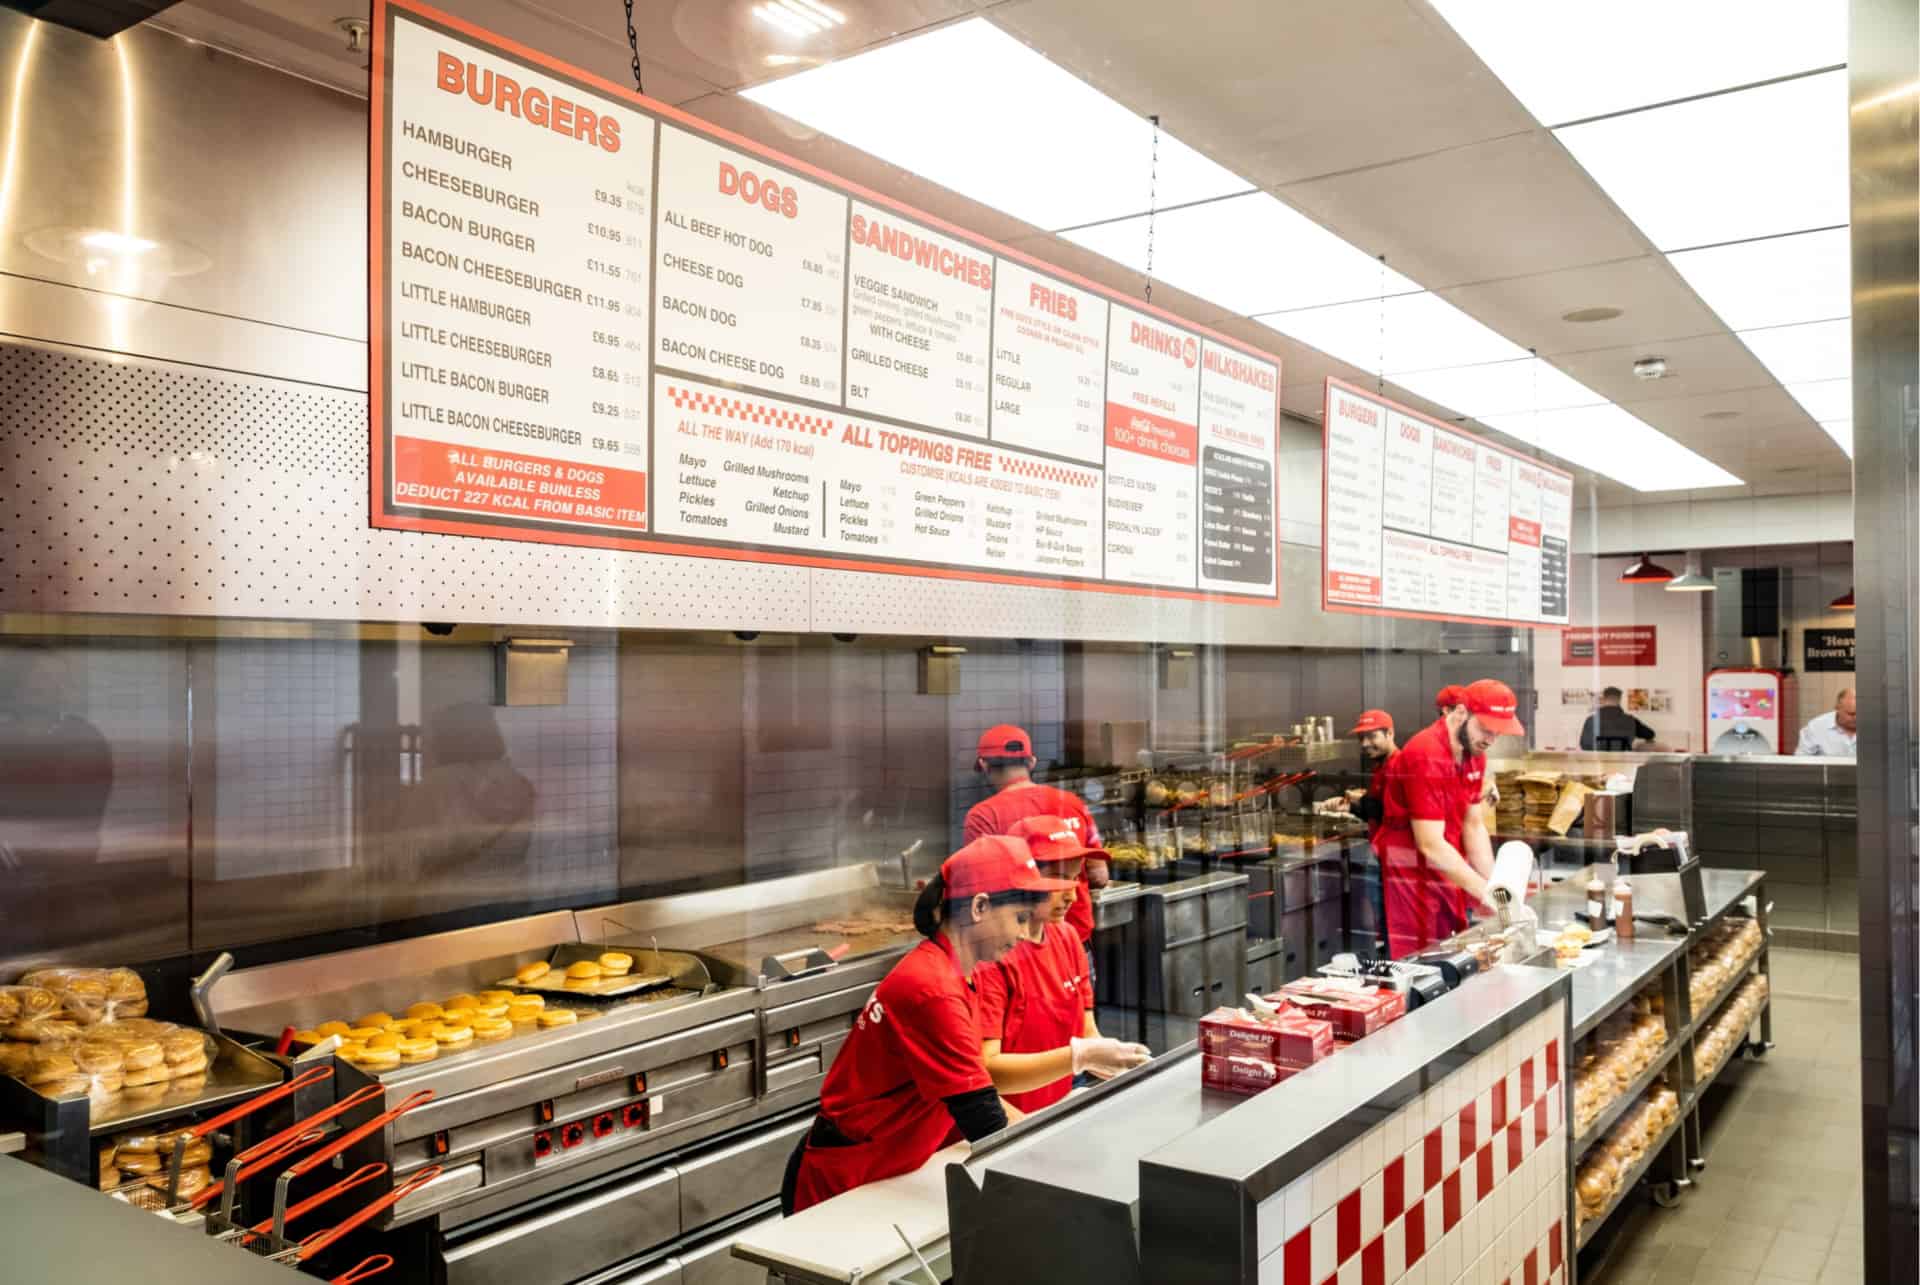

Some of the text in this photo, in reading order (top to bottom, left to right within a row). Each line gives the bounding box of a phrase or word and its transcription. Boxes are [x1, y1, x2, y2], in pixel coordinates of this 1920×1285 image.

[437, 50, 621, 153] BURGERS
[402, 120, 622, 208] HAMBURGER £9.35
[402, 160, 622, 243] CHEESEBURGER £10.95
[718, 161, 798, 219] DOGS
[402, 201, 621, 278] BACON BURGER £11.55
[664, 209, 688, 230] ALL
[690, 217, 721, 239] BEEF
[723, 228, 747, 248] HOT
[748, 238, 774, 258] DOG
[851, 214, 992, 290] SANDWICHES
[401, 241, 620, 313] BACON CHEESEBURGER £11.95
[663, 252, 713, 278] CHEESE
[716, 268, 744, 289] DOG
[853, 273, 889, 296] VEGGIE
[890, 286, 939, 313] SANDWICH
[1029, 282, 1077, 322] FRIES
[401, 281, 620, 348] LITTLE HAMBURGER £6.95
[662, 295, 707, 320] BACON
[709, 307, 737, 327] DOG
[401, 321, 619, 383] LITTLE CHEESEBURGER £8.65
[869, 323, 894, 339] WITH
[894, 331, 931, 352] CHEESE
[1130, 320, 1182, 361] DRINKS
[661, 338, 706, 361] BACON
[709, 348, 756, 373] CHEESE
[759, 361, 785, 379] DOG
[851, 347, 930, 379] GRILLED CHEESE
[996, 349, 1021, 365] LITTLE
[1204, 348, 1275, 392] MILKSHAKES
[401, 361, 447, 385] LITTLE
[450, 371, 495, 394] BACON
[498, 380, 549, 403] BURGER
[850, 384, 870, 400] BLT
[996, 374, 1032, 393] REGULAR
[995, 399, 1022, 416] LARGE
[401, 402, 619, 453] LITTLE BACON CHEESEBURGER £9.65
[677, 416, 700, 437] ALL
[701, 423, 723, 441] THE
[724, 430, 749, 447] WAY
[841, 423, 993, 472] ALL TOPPINGS FREE
[451, 451, 605, 484] ALL BURGERS & DOGS
[679, 452, 809, 486] Mayo Grilled Mushrooms
[396, 482, 645, 523] DEDUCT 227 KCAL FROM BASIC ITEM
[455, 471, 600, 501] AVAILABLE BUNLESS
[679, 472, 810, 503] Lettuce Ketchup
[839, 479, 863, 494] Mayo
[914, 490, 937, 504] Green
[679, 490, 809, 520] Pickles Grilled Onions
[839, 496, 871, 512] Lettuce
[839, 513, 869, 528] Pickles
[679, 509, 810, 537] Tomatoes Mustard
[839, 529, 879, 545] Tomatoes
[914, 523, 928, 535] Hot
[1230, 1030, 1259, 1044] Delight
[1232, 1064, 1262, 1079] Delight
